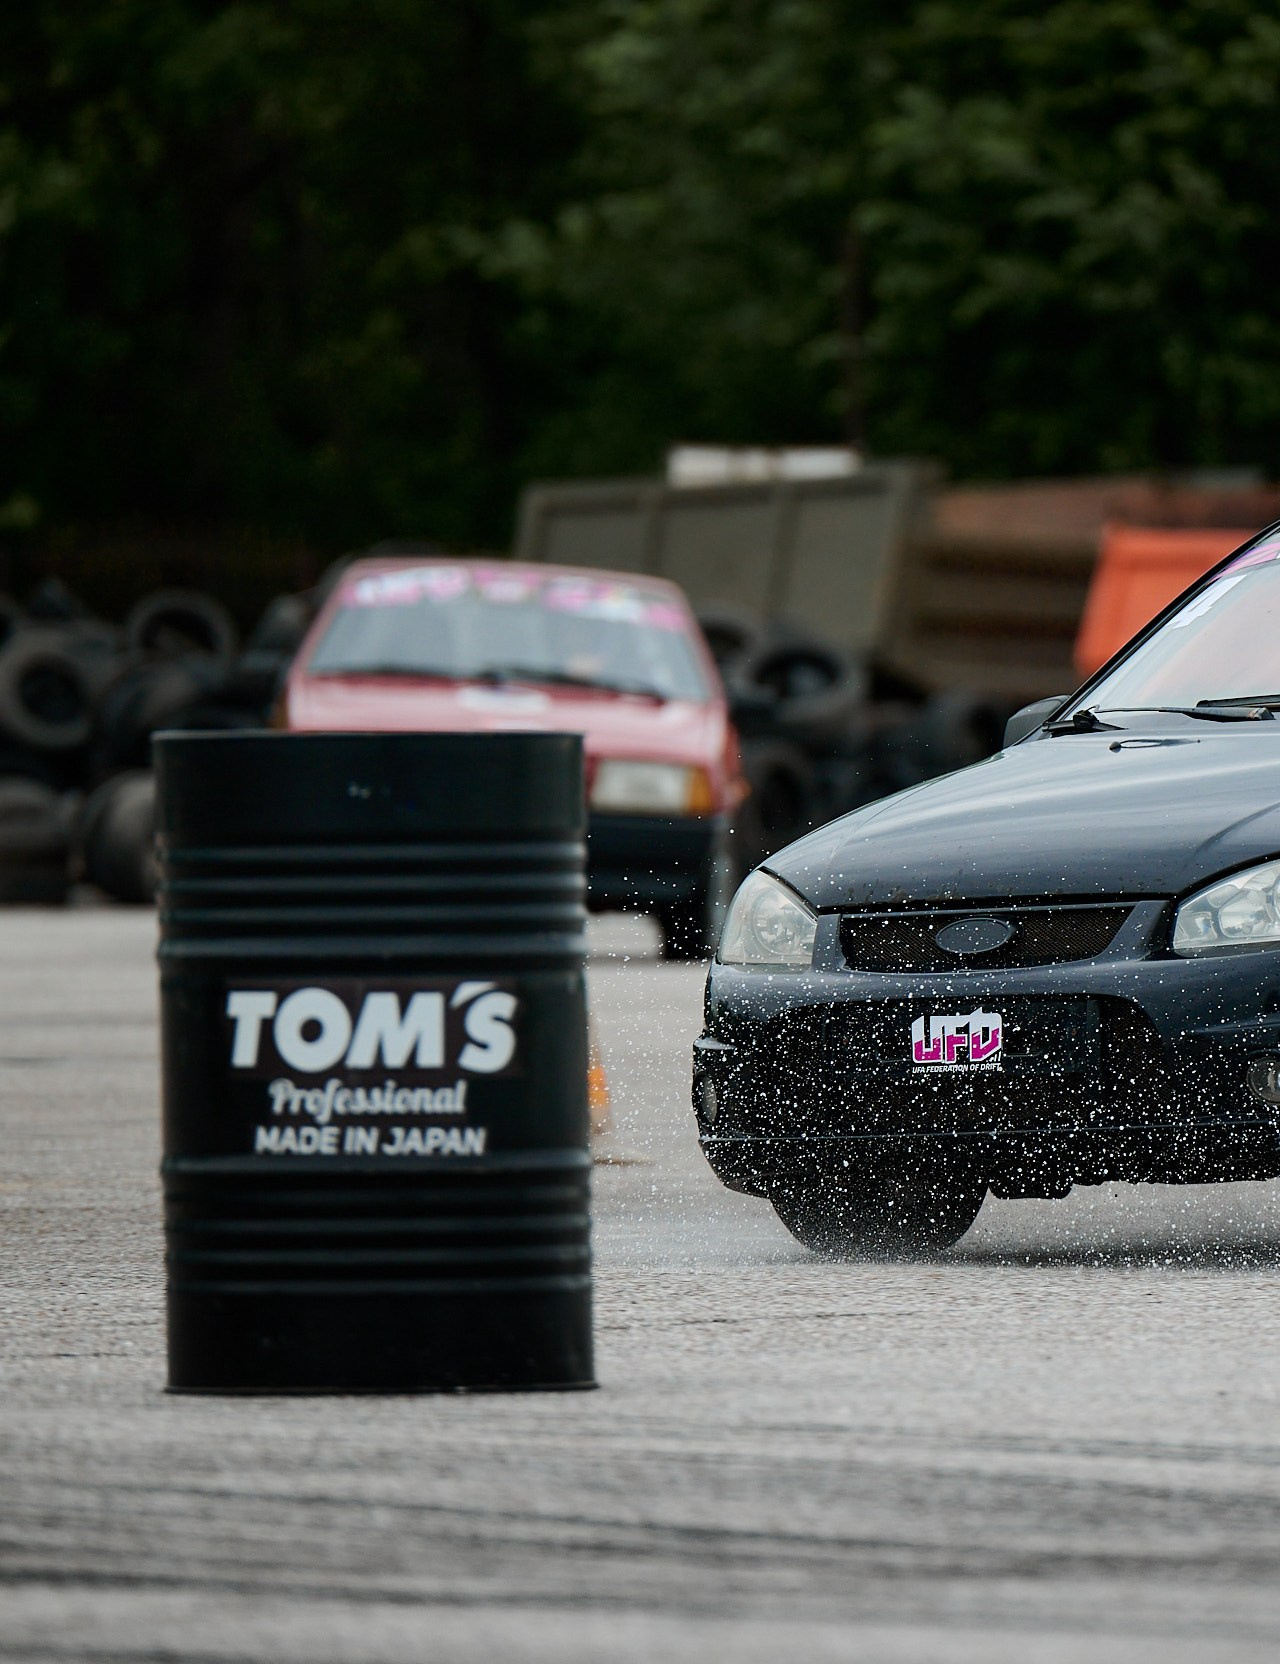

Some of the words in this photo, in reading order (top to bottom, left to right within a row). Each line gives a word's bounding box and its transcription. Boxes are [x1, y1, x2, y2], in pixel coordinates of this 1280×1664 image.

[226, 980, 519, 1074] TOM'S
[911, 1006, 1003, 1064] UFD
[912, 1065, 926, 1074] UFA
[926, 1063, 969, 1074] FEDERATION
[969, 1063, 980, 1072] OF
[980, 1062, 1002, 1072] DRIFT
[267, 1077, 468, 1125] Professional
[254, 1124, 341, 1156] MADE
[343, 1125, 380, 1156] IN
[381, 1126, 487, 1157] JAPAN
